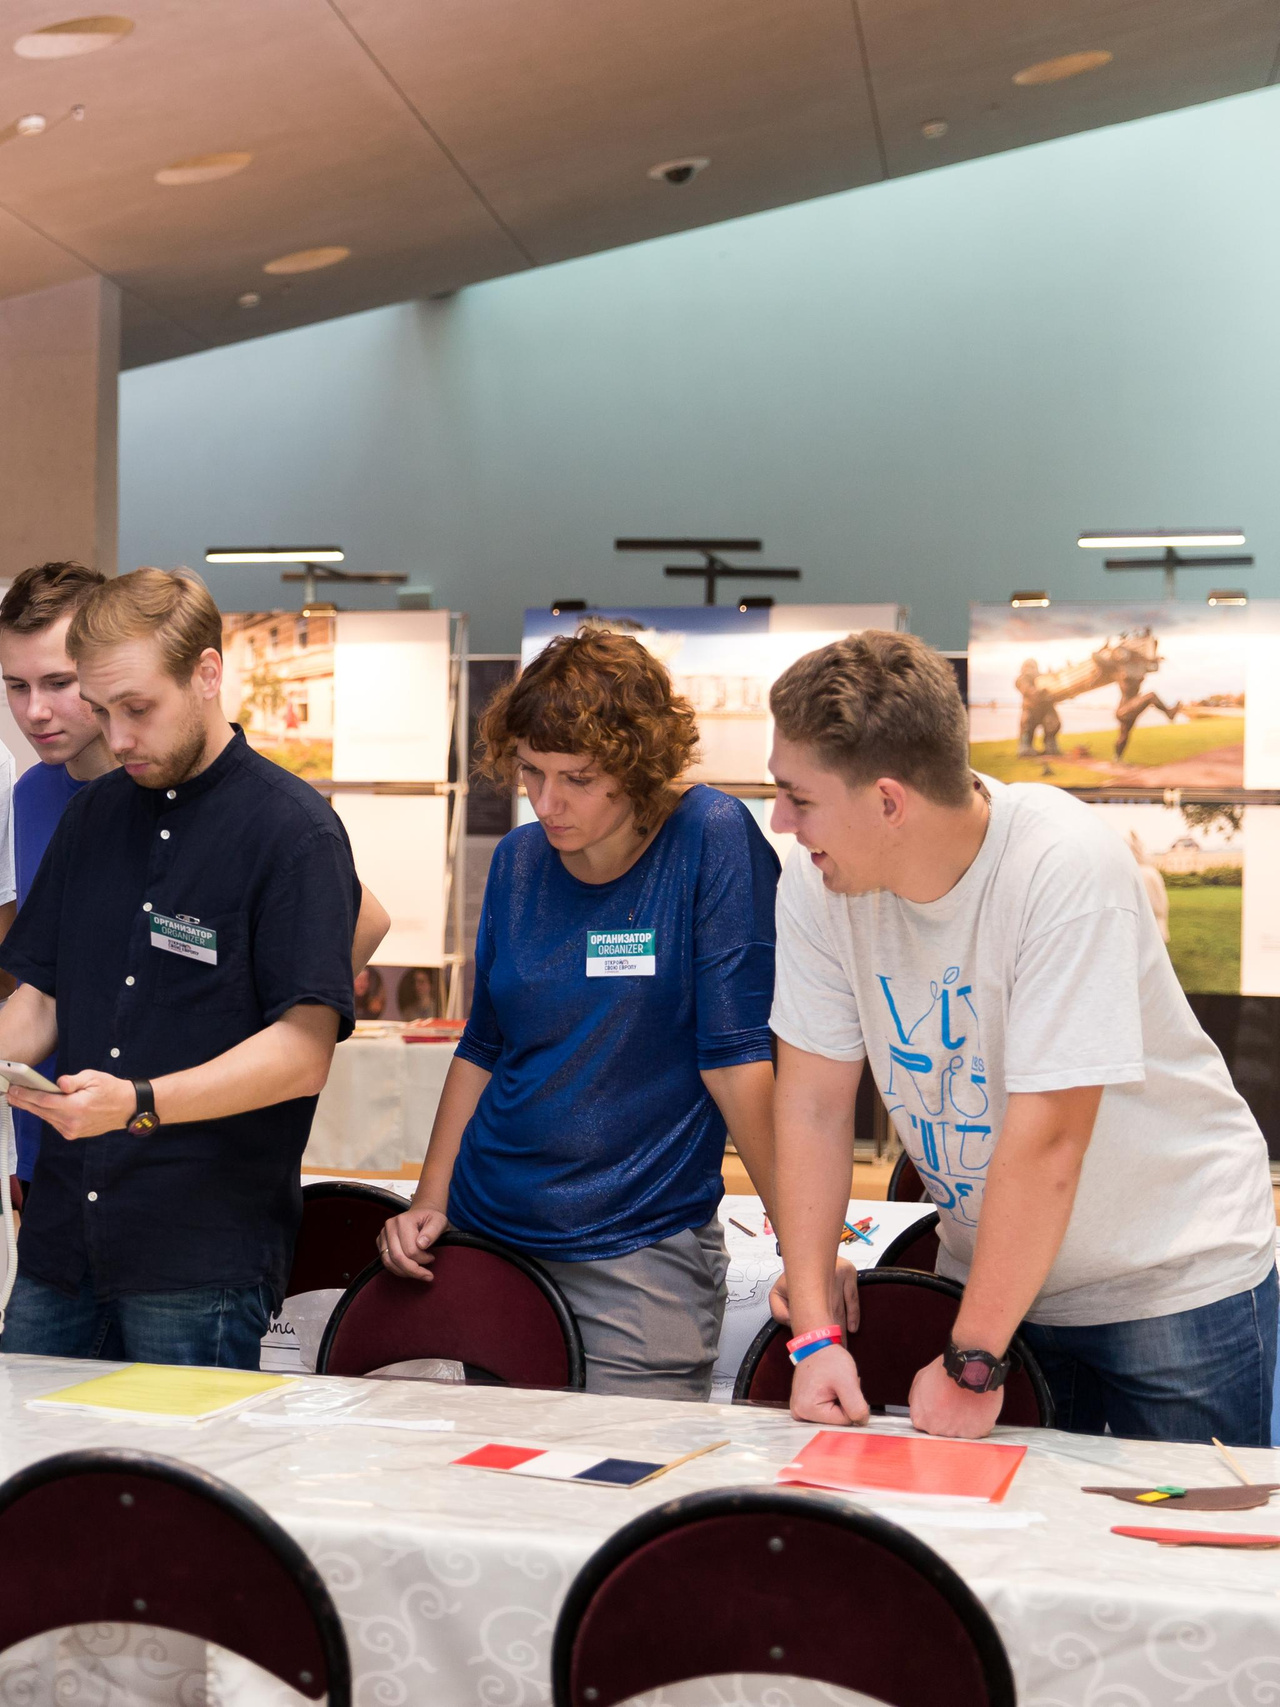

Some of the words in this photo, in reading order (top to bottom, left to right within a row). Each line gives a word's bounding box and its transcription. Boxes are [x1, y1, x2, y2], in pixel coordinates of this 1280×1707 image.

[153, 916, 213, 940] ОРГАНИЗАТОР
[161, 926, 206, 946] ORGANIZER
[590, 932, 652, 945] ОРГАНИЗАТОР
[598, 943, 644, 955] ORGANIZER
